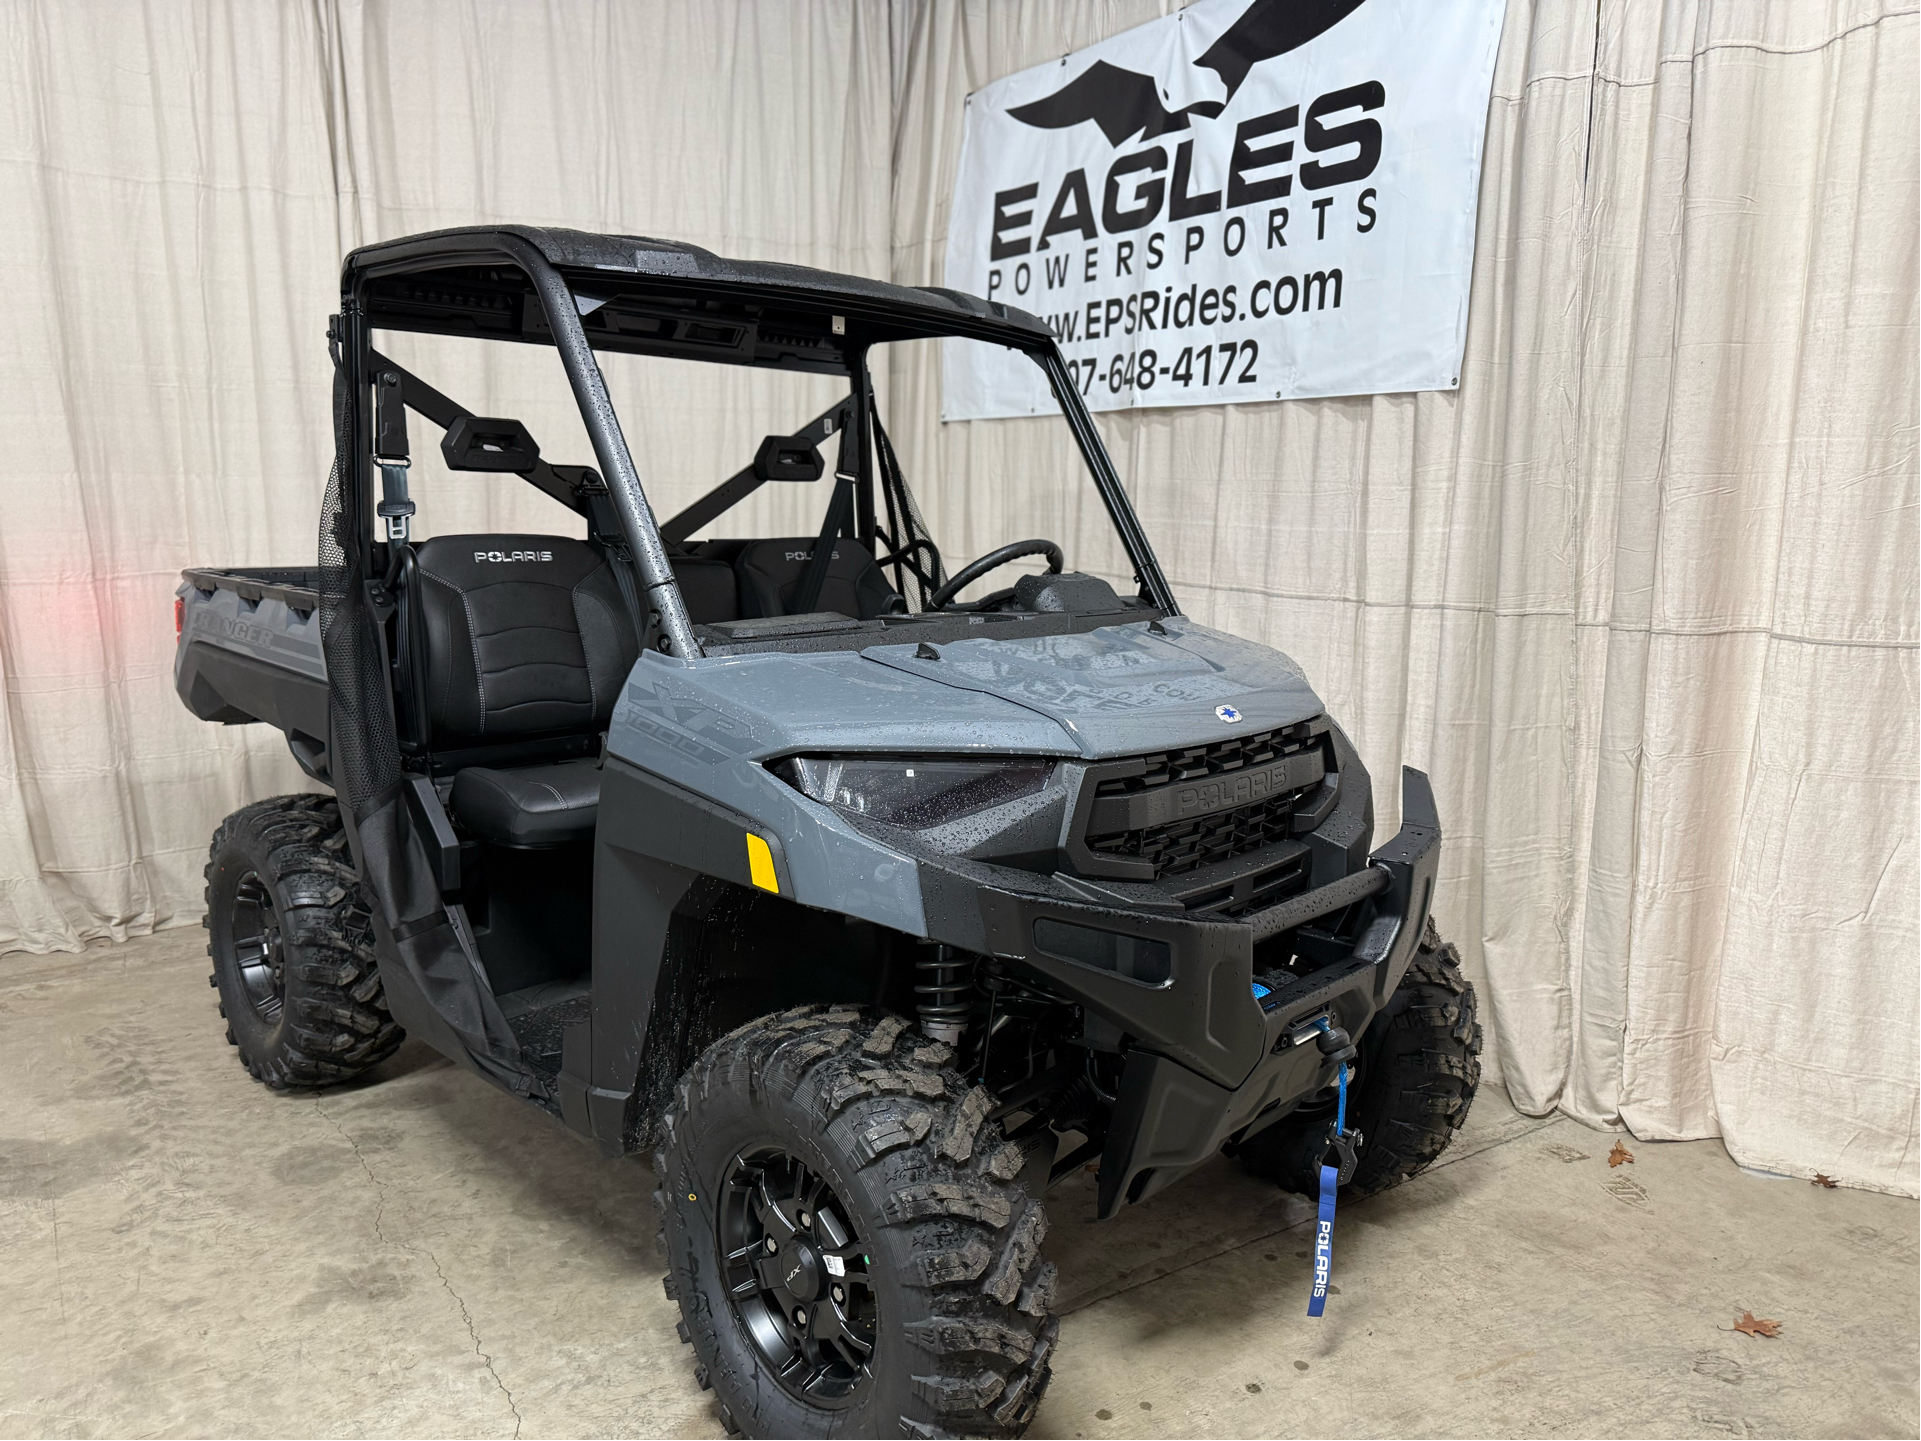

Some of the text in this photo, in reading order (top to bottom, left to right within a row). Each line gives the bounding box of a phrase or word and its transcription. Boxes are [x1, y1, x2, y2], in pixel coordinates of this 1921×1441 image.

[989, 80, 1386, 261] EAGLES
[988, 188, 1378, 301] POWERSPORTS
[473, 550, 553, 564] POLARIS
[784, 550, 840, 562] POLS
[198, 611, 275, 649] RANGER
[1177, 764, 1287, 817] POLARIS
[786, 1263, 802, 1282] XP
[1314, 1220, 1331, 1297] POLARIS
